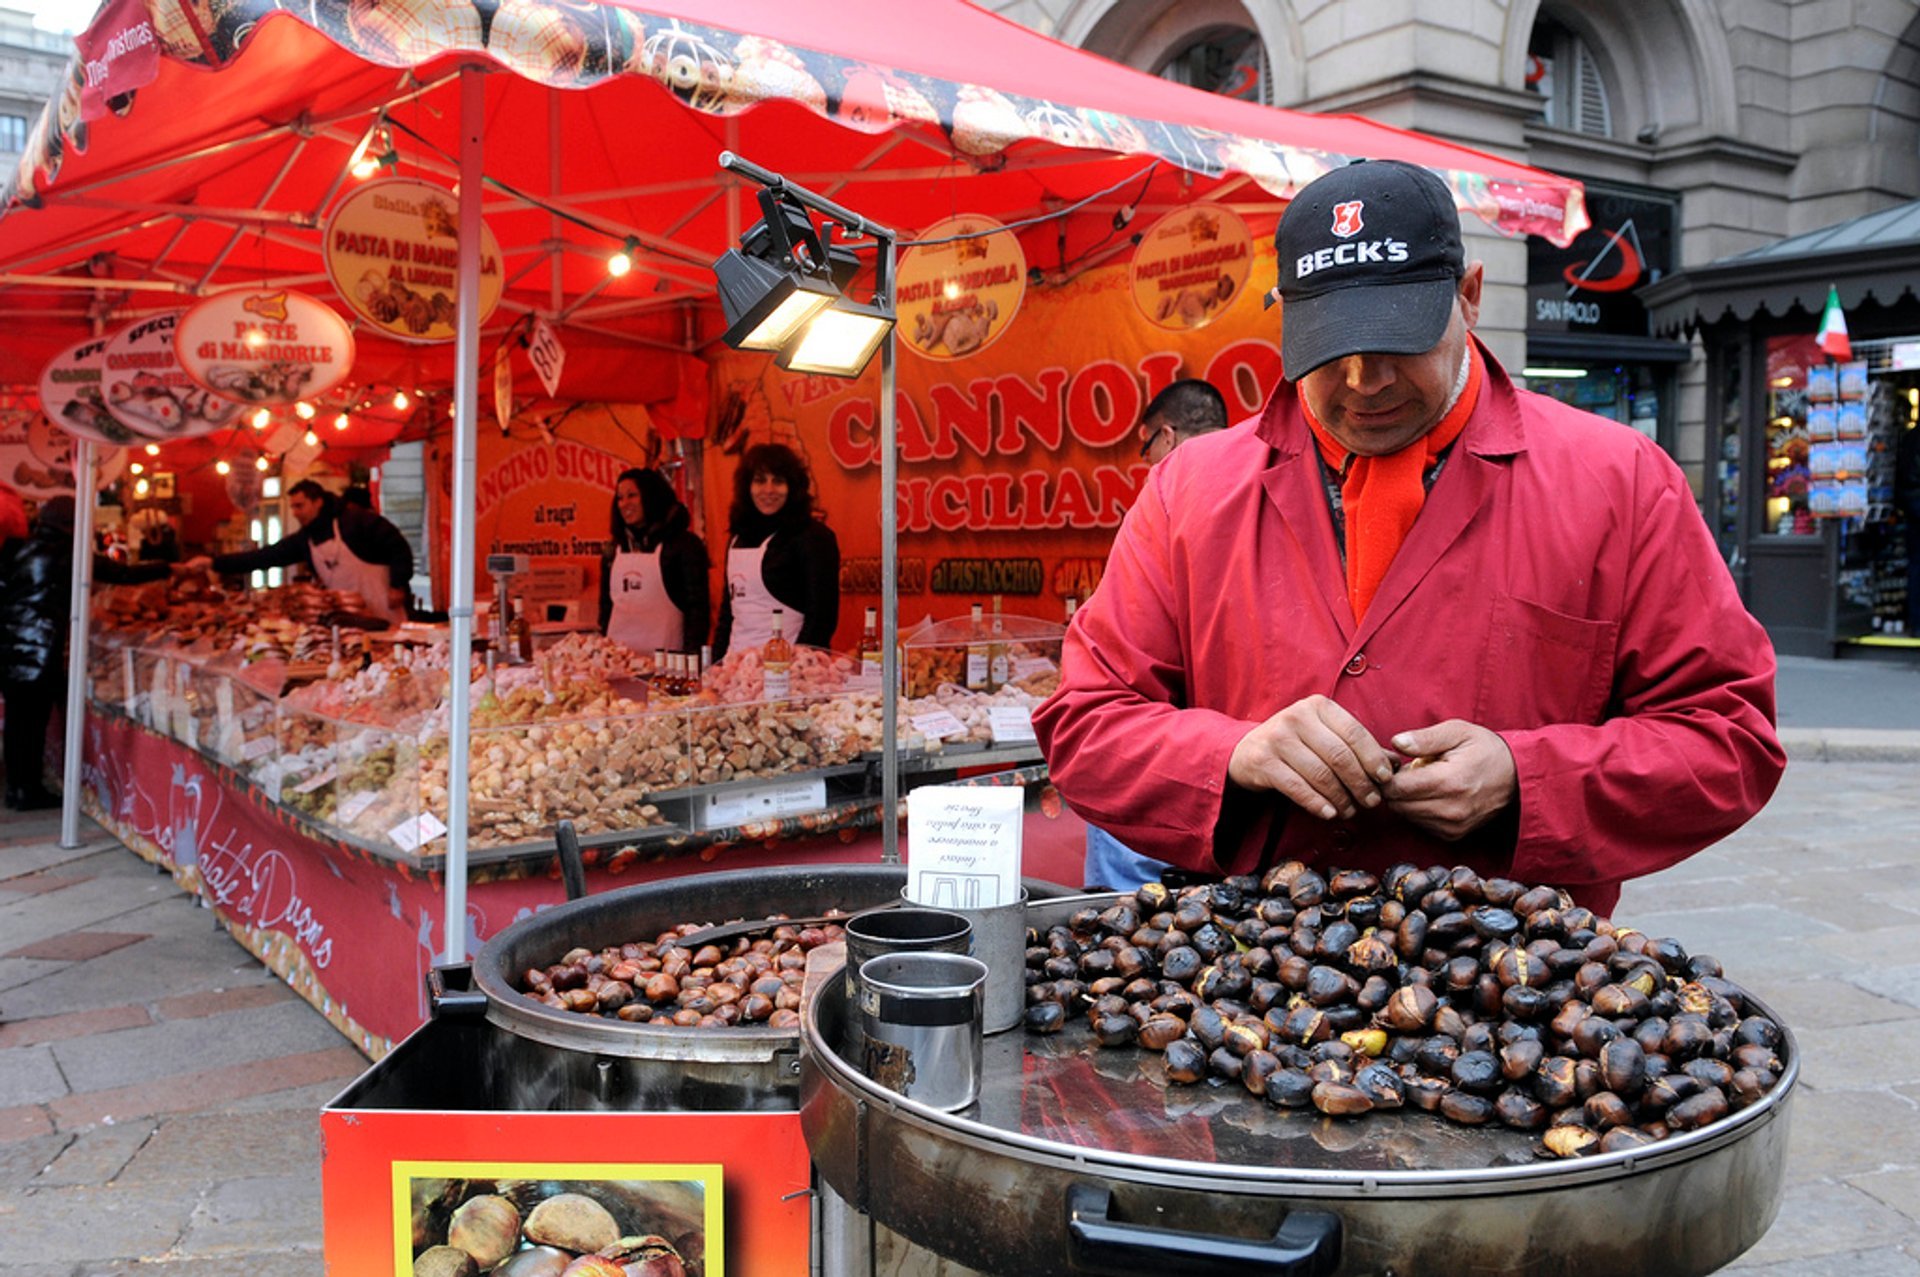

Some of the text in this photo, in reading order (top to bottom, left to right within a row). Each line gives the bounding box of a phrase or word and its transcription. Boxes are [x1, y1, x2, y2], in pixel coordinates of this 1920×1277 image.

[335, 229, 498, 276] PASTA DI MANDLA
[1296, 237, 1409, 279] BECK'S
[387, 264, 454, 290] AL LIMONE
[1136, 260, 1168, 281] PASTA
[896, 281, 931, 305] PASTA
[1535, 298, 1601, 324] SAN PAOLO
[197, 341, 333, 364] di MANDORLE
[826, 338, 1284, 470] CANNOLO
[534, 504, 545, 524] al
[949, 558, 1043, 594] PISTACCHIO
[251, 849, 334, 969] Duomo
